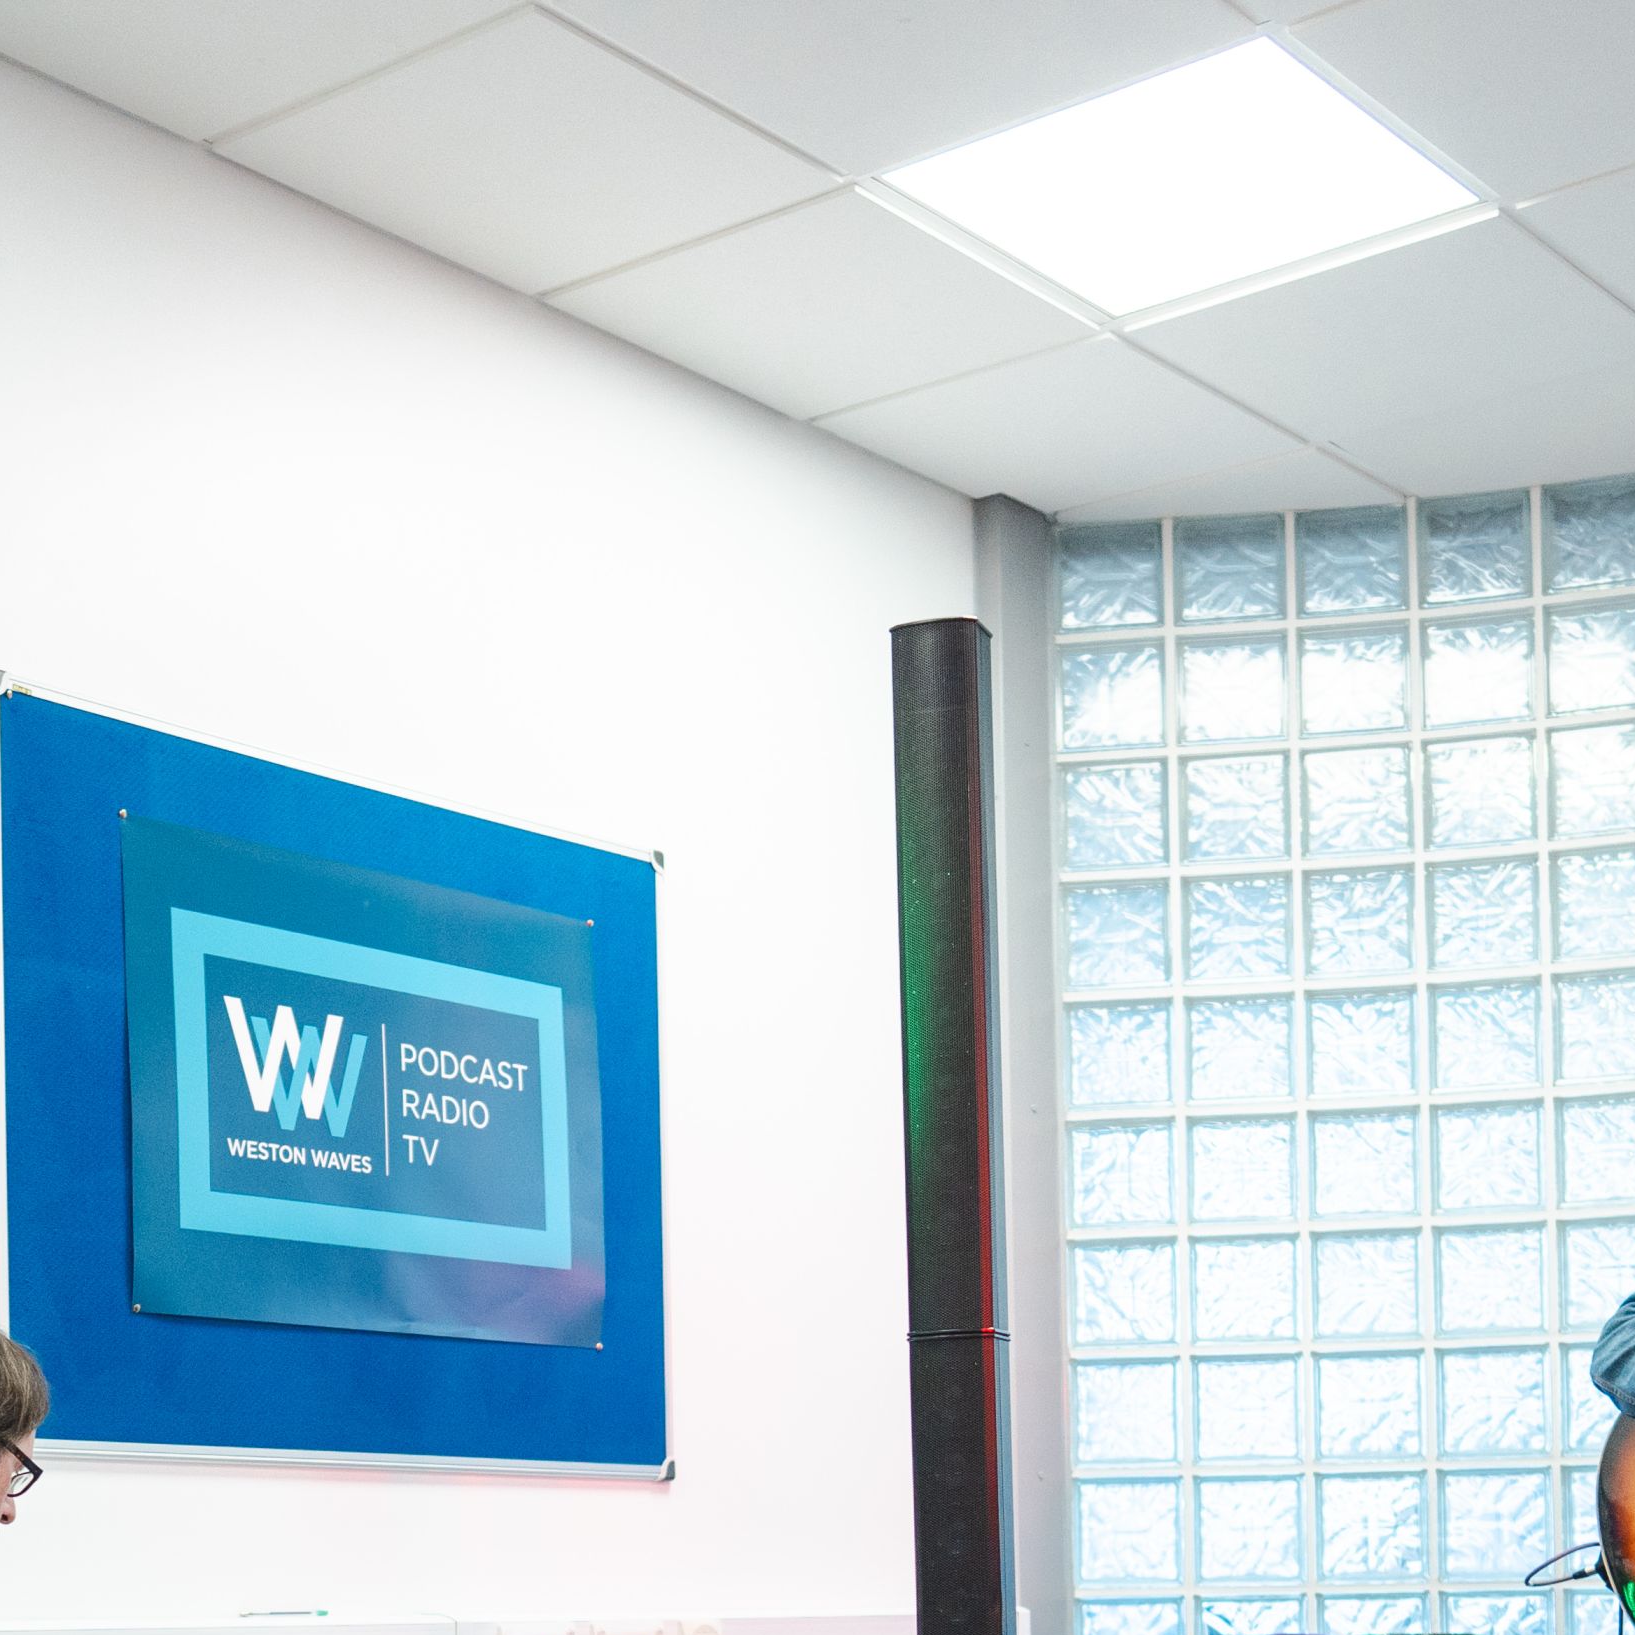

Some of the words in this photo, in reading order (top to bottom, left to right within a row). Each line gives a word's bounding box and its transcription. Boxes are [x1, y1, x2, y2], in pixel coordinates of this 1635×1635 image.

[400, 1042, 528, 1092] PODCAST
[402, 1088, 490, 1130] RADIO
[226, 1136, 307, 1166] WESTON
[311, 1148, 373, 1174] WAVES
[402, 1134, 439, 1167] TV
